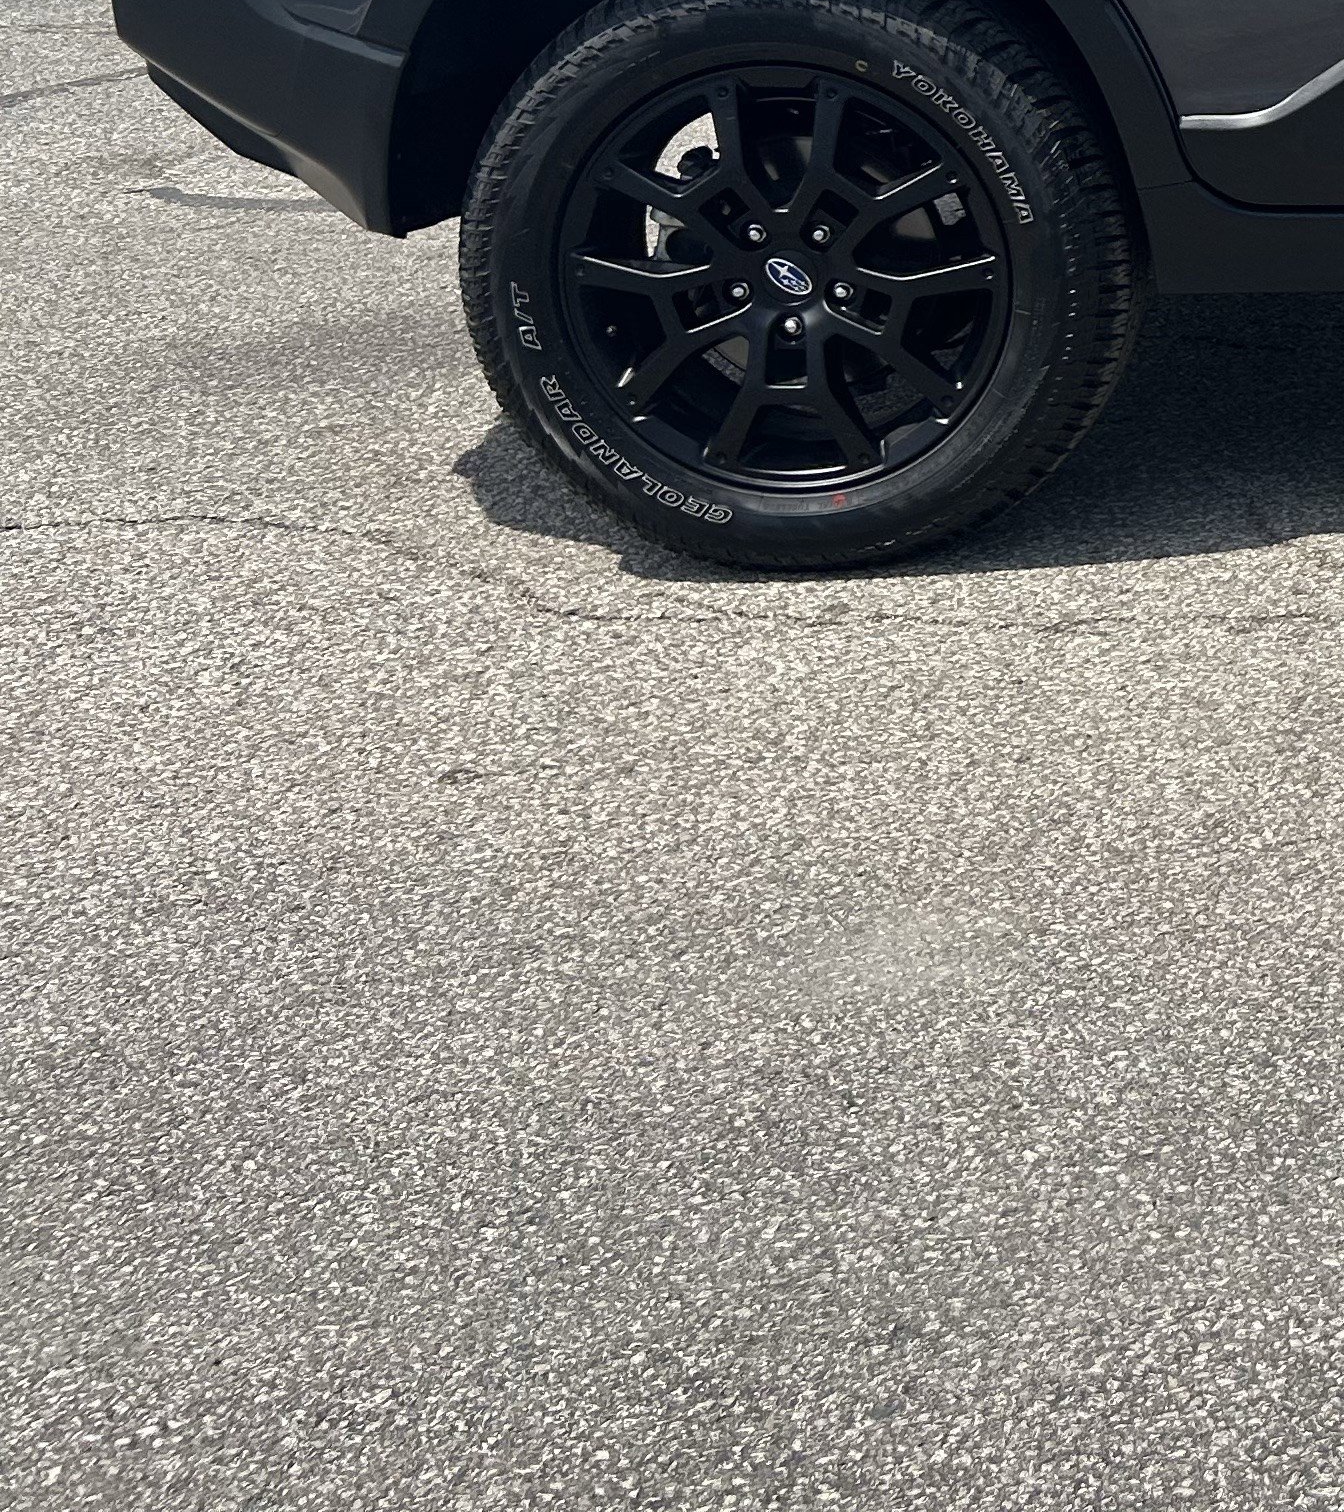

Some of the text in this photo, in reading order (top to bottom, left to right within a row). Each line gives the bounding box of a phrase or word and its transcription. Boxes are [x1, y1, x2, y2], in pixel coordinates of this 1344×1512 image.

[891, 59, 1034, 225] YOKOHAMA
[511, 282, 734, 523] GEOLANDAR A/T
